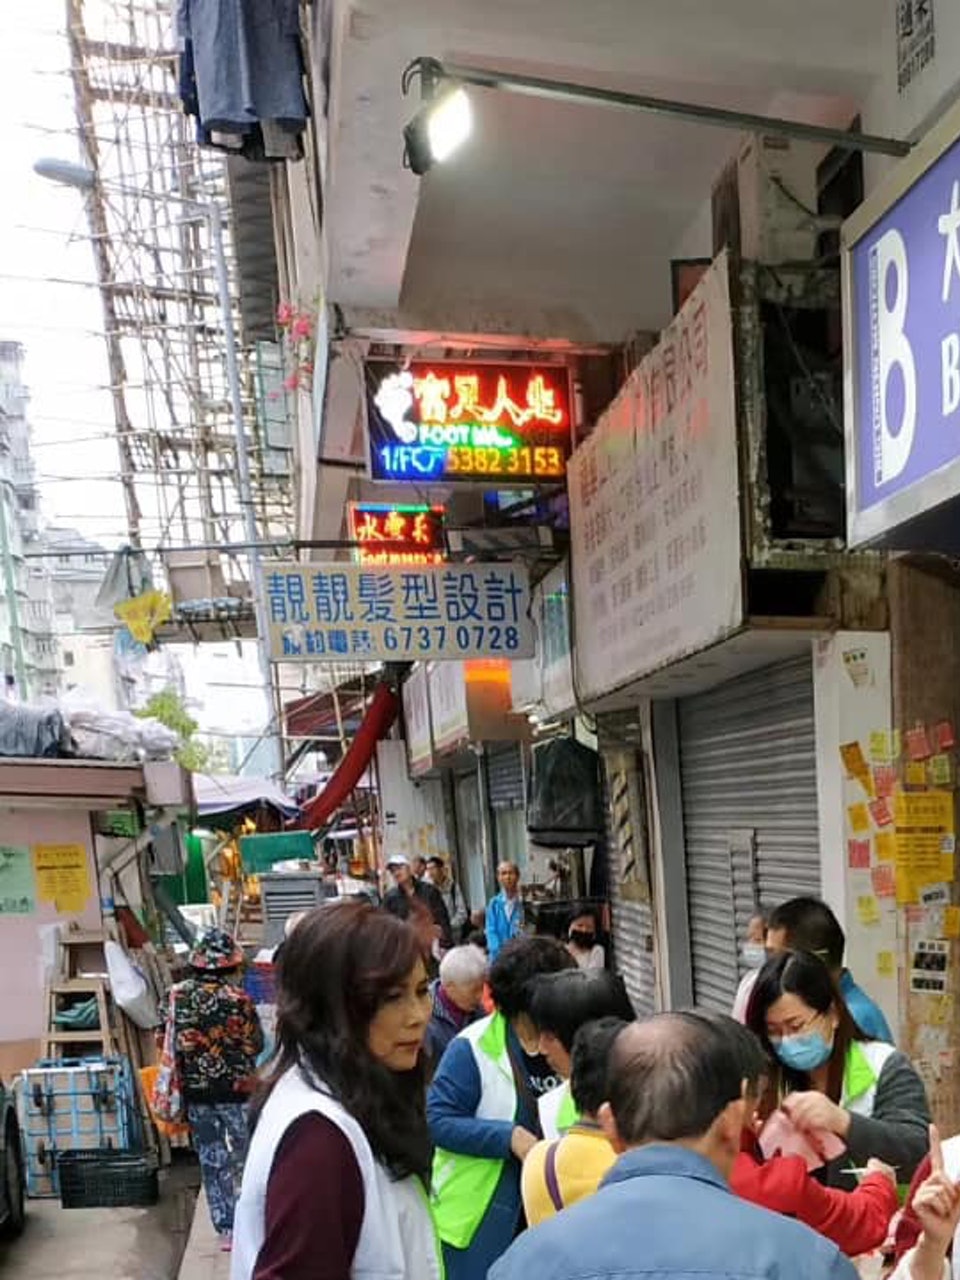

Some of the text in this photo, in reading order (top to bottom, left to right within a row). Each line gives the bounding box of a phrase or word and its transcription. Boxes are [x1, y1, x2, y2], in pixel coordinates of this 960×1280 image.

[419, 425, 470, 445] FOOT
[267, 571, 523, 623] 靚靚髮型設計
[383, 626, 446, 650] 6737
[456, 625, 519, 650] 0728
